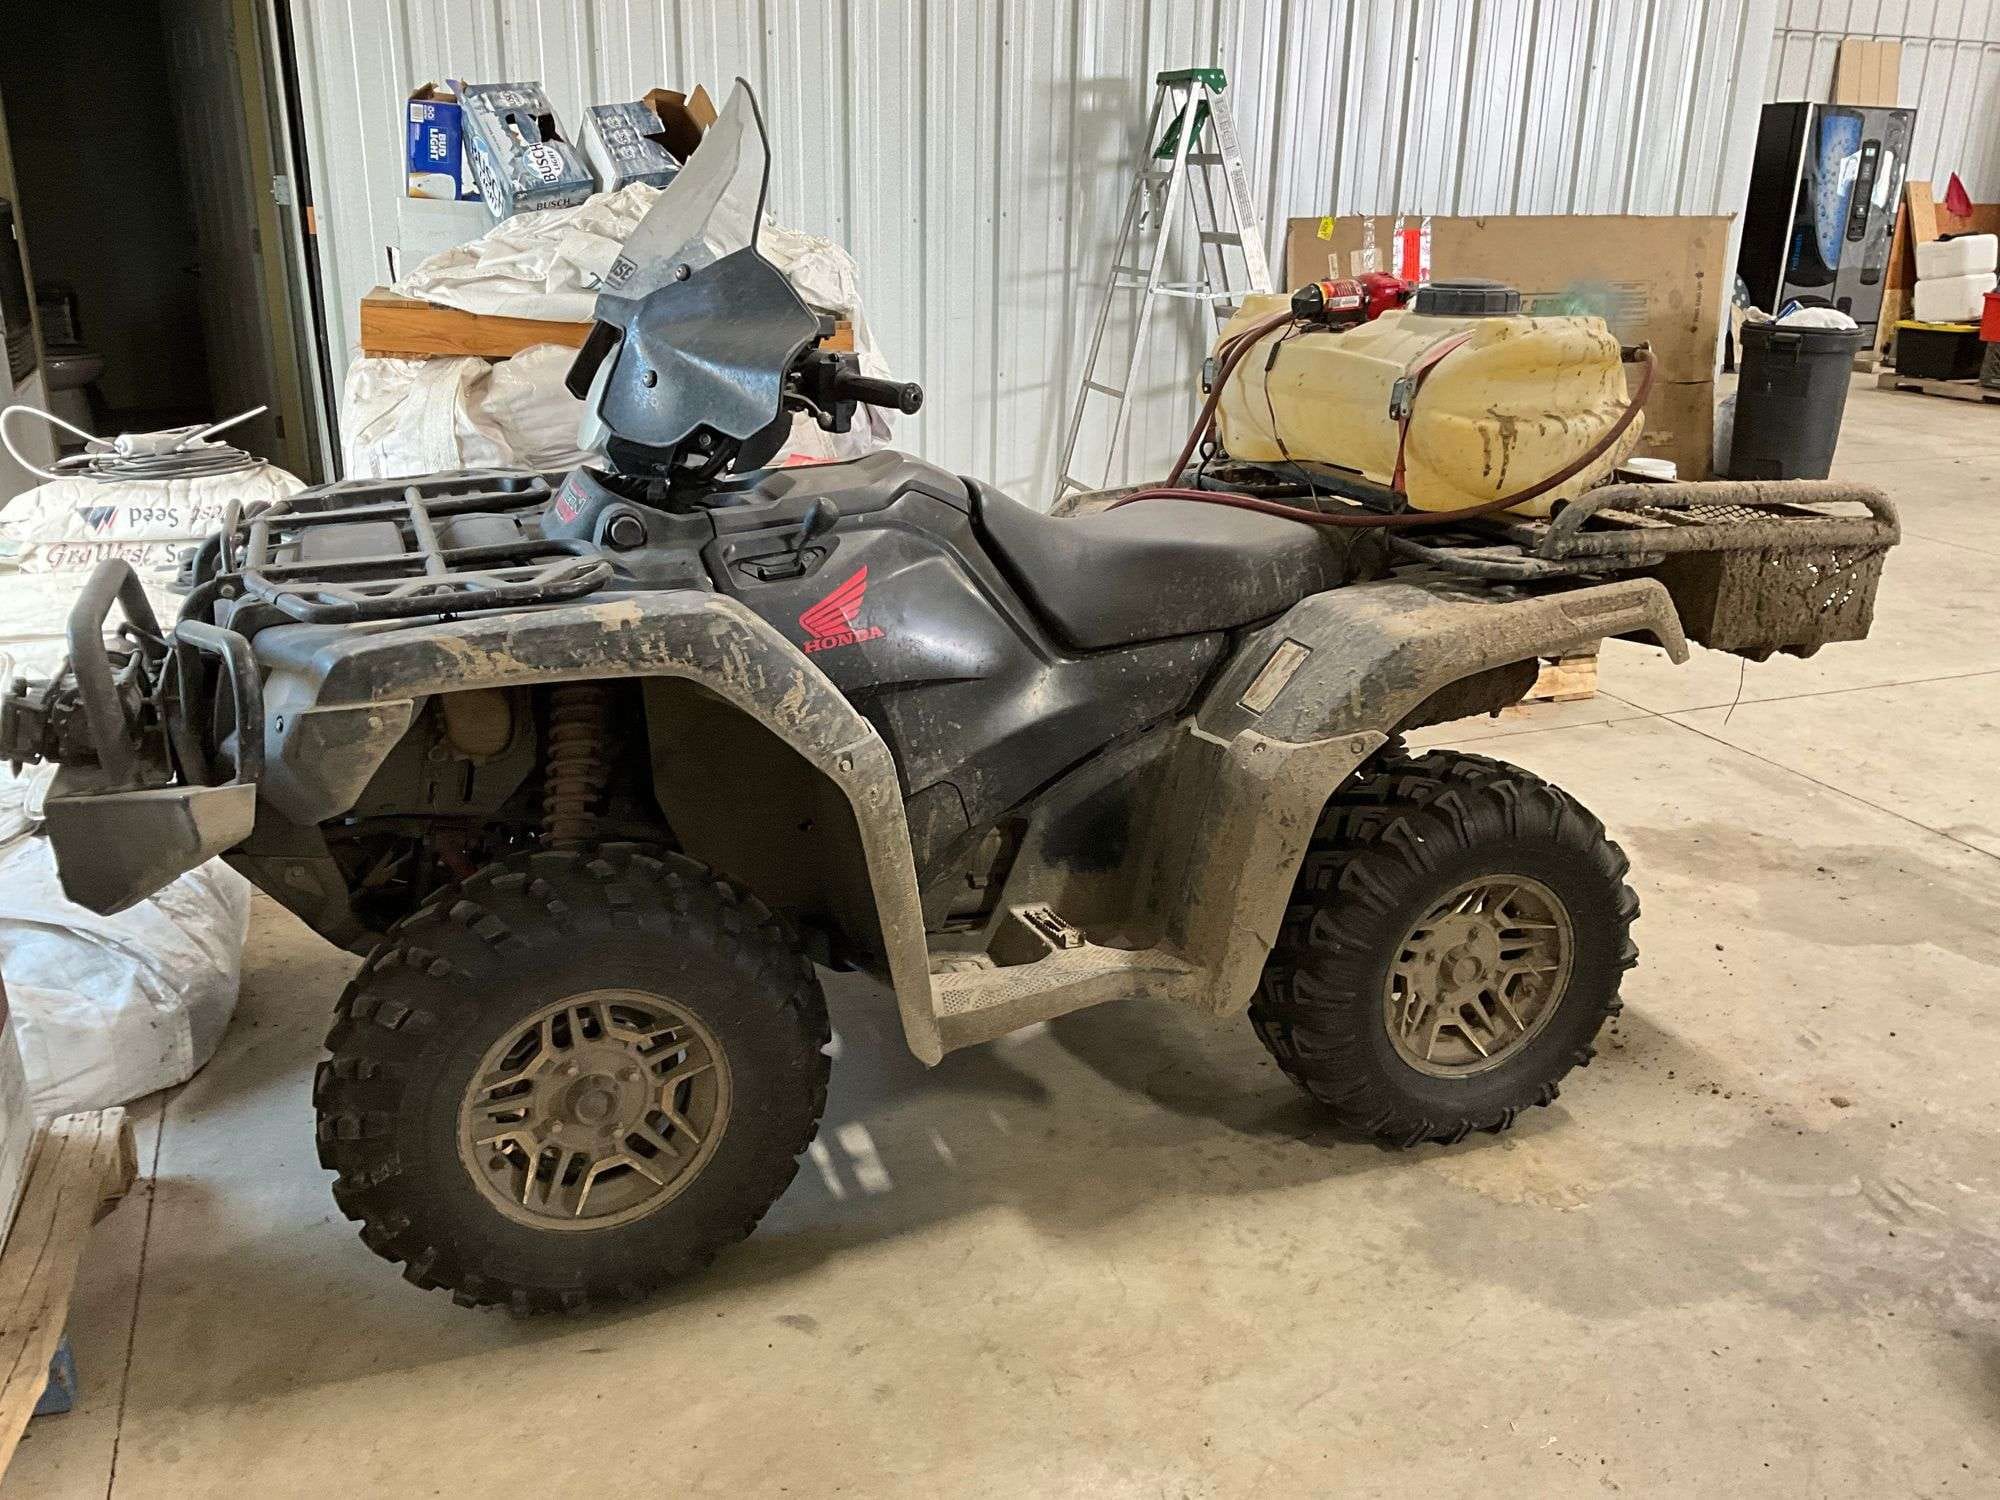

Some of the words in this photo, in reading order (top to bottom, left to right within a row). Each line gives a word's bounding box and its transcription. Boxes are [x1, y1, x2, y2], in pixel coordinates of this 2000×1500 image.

[429, 128, 439, 161] LIGHT
[438, 133, 447, 157] BUD
[529, 143, 557, 182] BUSCH
[536, 198, 571, 211] BUSCH
[129, 506, 179, 528] Seed
[803, 625, 886, 653] HONDA
